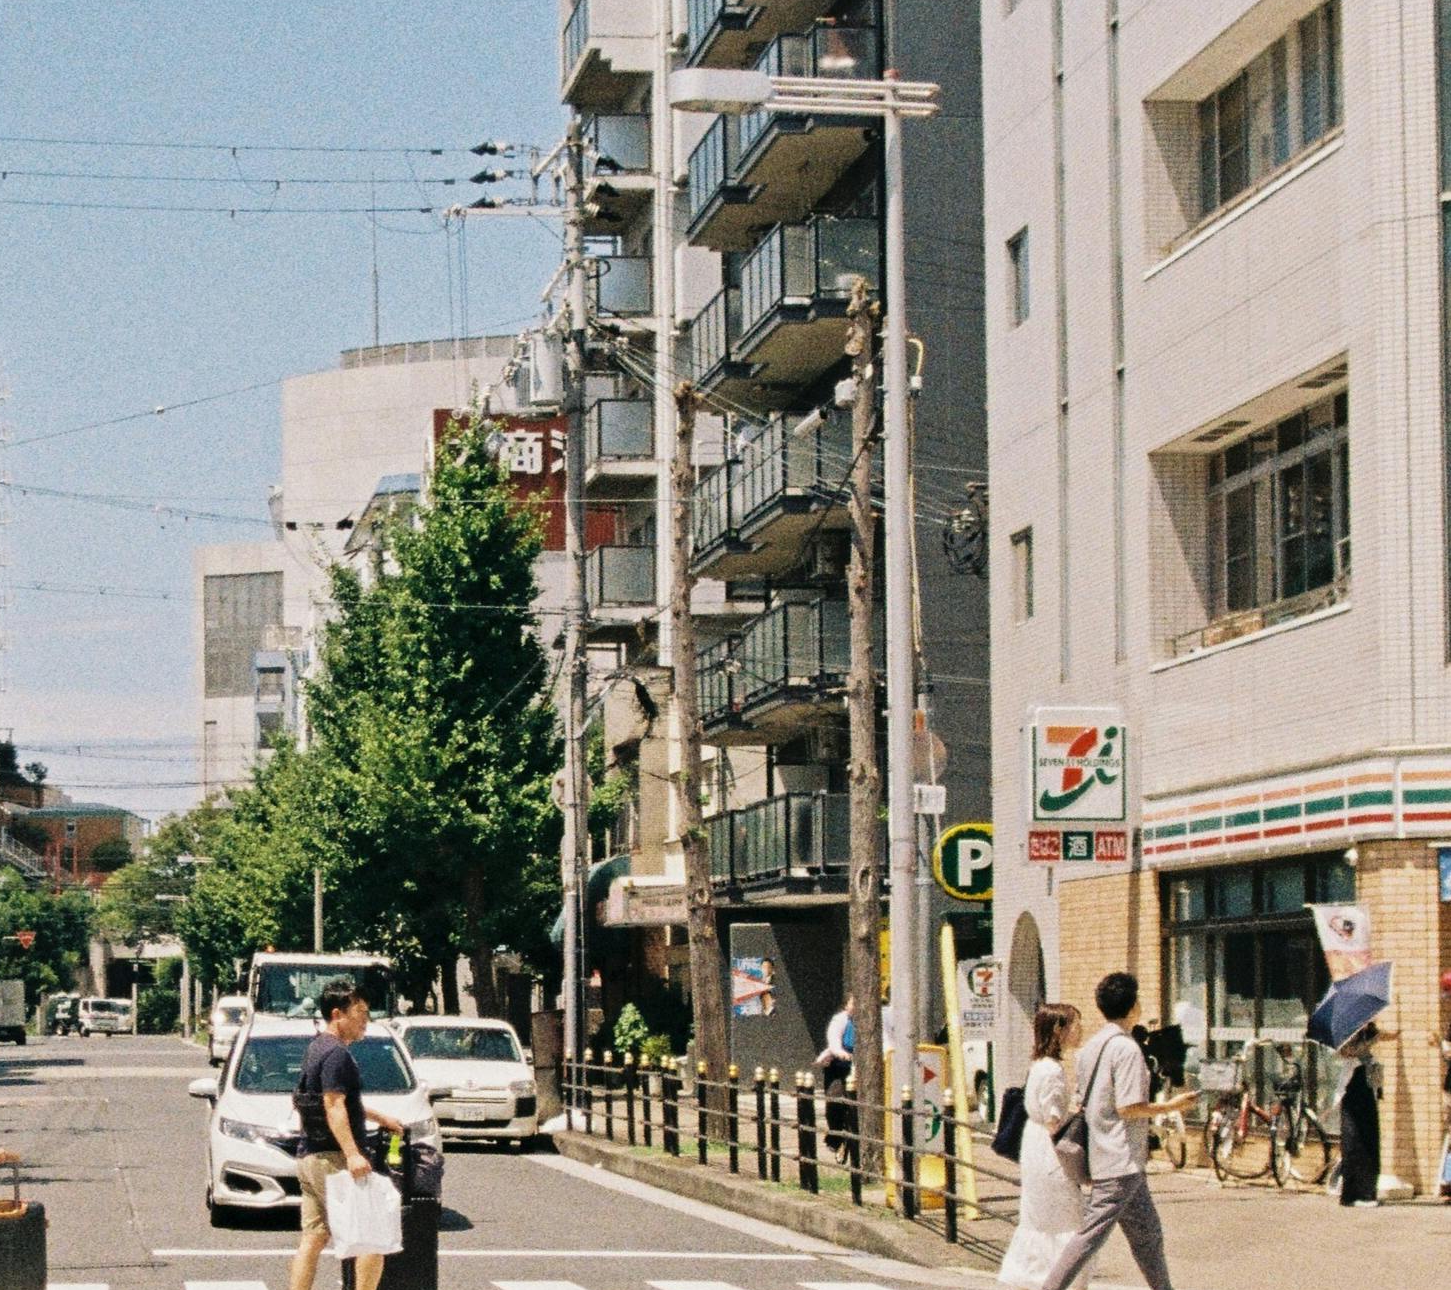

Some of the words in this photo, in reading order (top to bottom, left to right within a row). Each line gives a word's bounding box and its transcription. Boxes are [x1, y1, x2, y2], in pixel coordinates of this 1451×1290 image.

[958, 839, 993, 886] P
[1067, 836, 1089, 860] 酒
[1097, 837, 1126, 856] ATM
